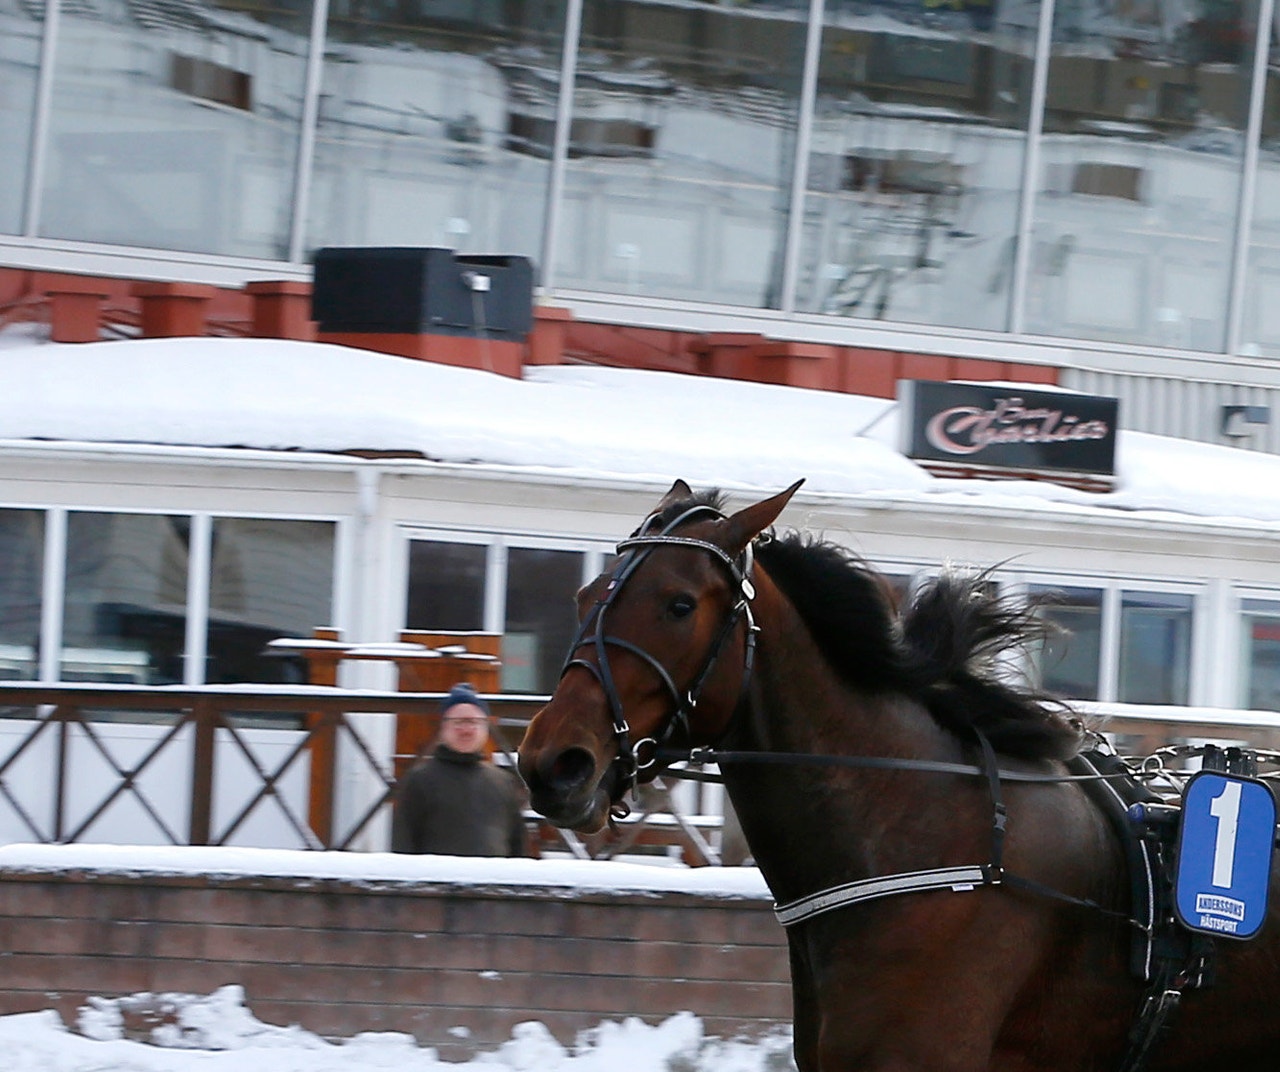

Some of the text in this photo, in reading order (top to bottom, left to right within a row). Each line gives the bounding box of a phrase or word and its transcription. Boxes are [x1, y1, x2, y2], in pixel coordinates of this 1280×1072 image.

[1210, 781, 1243, 889] 1
[1199, 897, 1243, 917] ANDERSSONS
[1200, 913, 1239, 933] HÄSTSPORT
